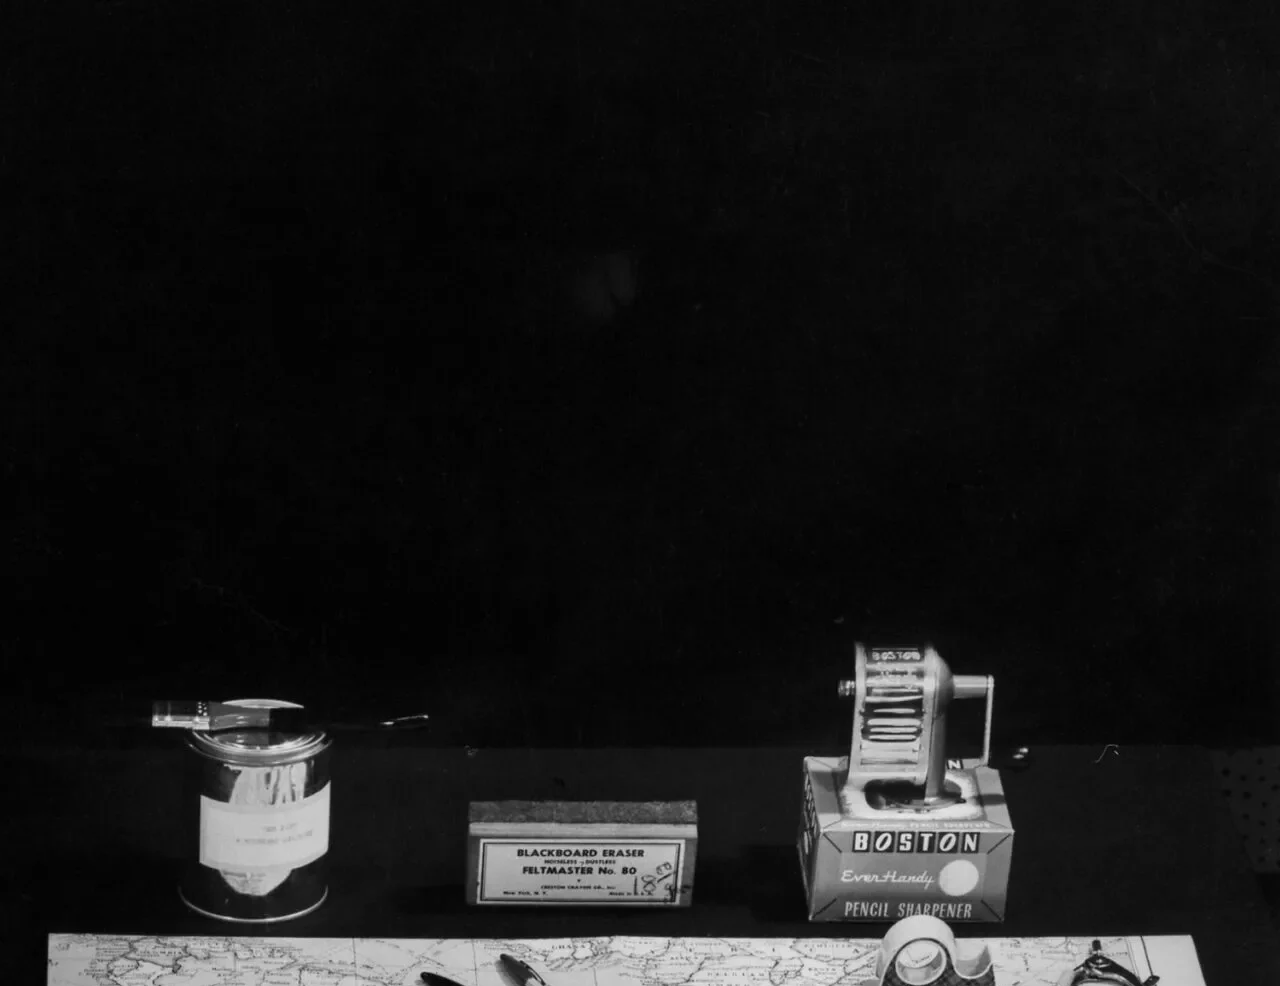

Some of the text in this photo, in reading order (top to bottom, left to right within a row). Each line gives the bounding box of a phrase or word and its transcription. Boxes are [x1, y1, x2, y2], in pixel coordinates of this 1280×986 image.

[854, 832, 979, 852] BOSTON
[516, 848, 646, 858] BLACKBOARD ERASER
[522, 866, 638, 876] FELTMASTER No. 80
[844, 900, 972, 919] PENCIL SHARPENER
